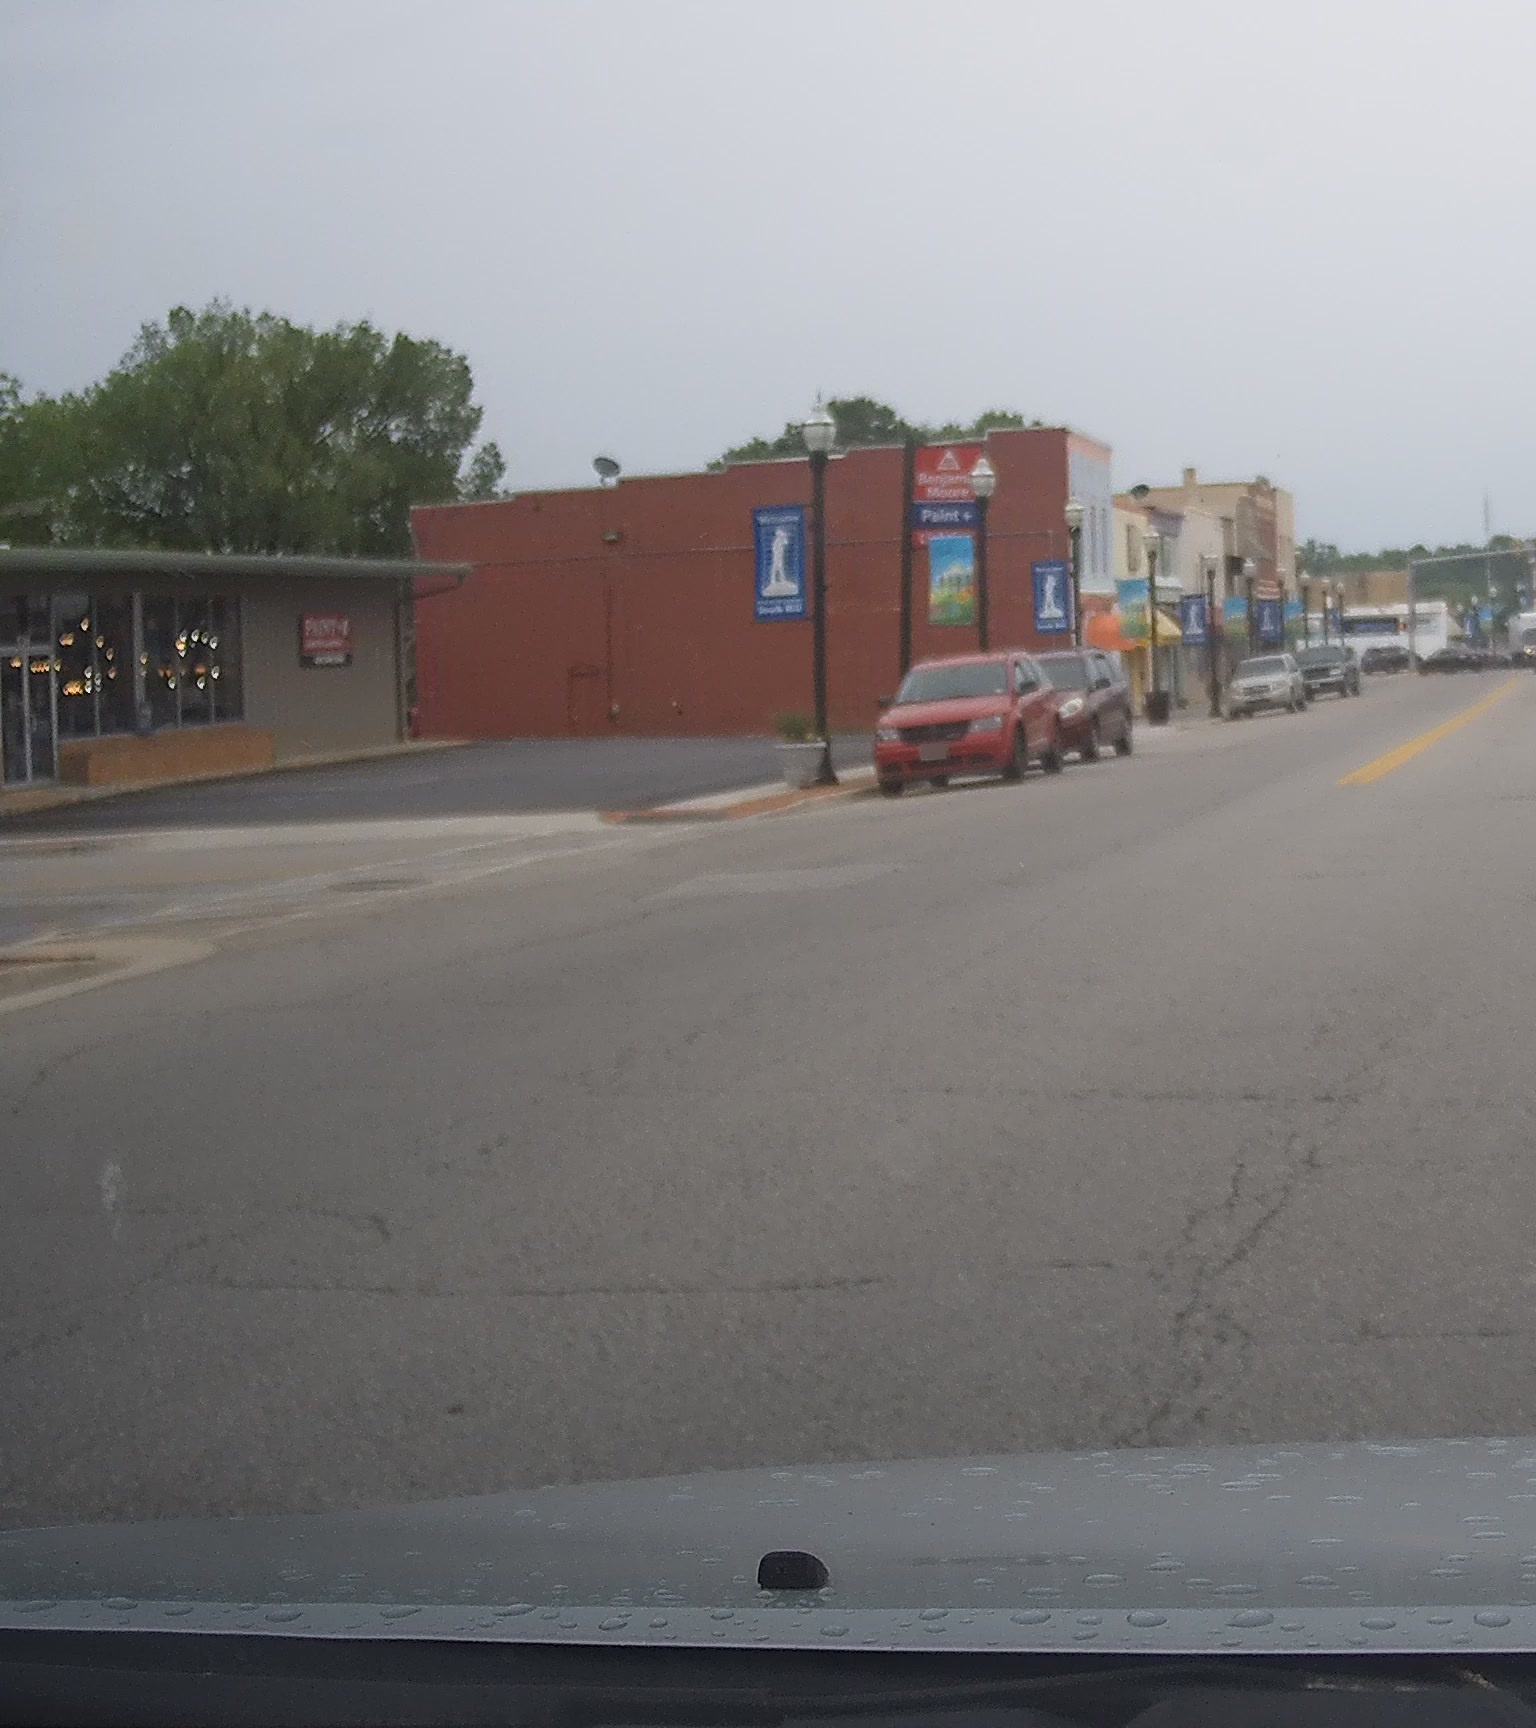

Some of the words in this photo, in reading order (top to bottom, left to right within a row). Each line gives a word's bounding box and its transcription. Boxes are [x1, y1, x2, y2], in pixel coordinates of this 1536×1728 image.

[918, 472, 969, 488] Benjam
[927, 487, 970, 498] Moore
[922, 509, 960, 523] Paint
